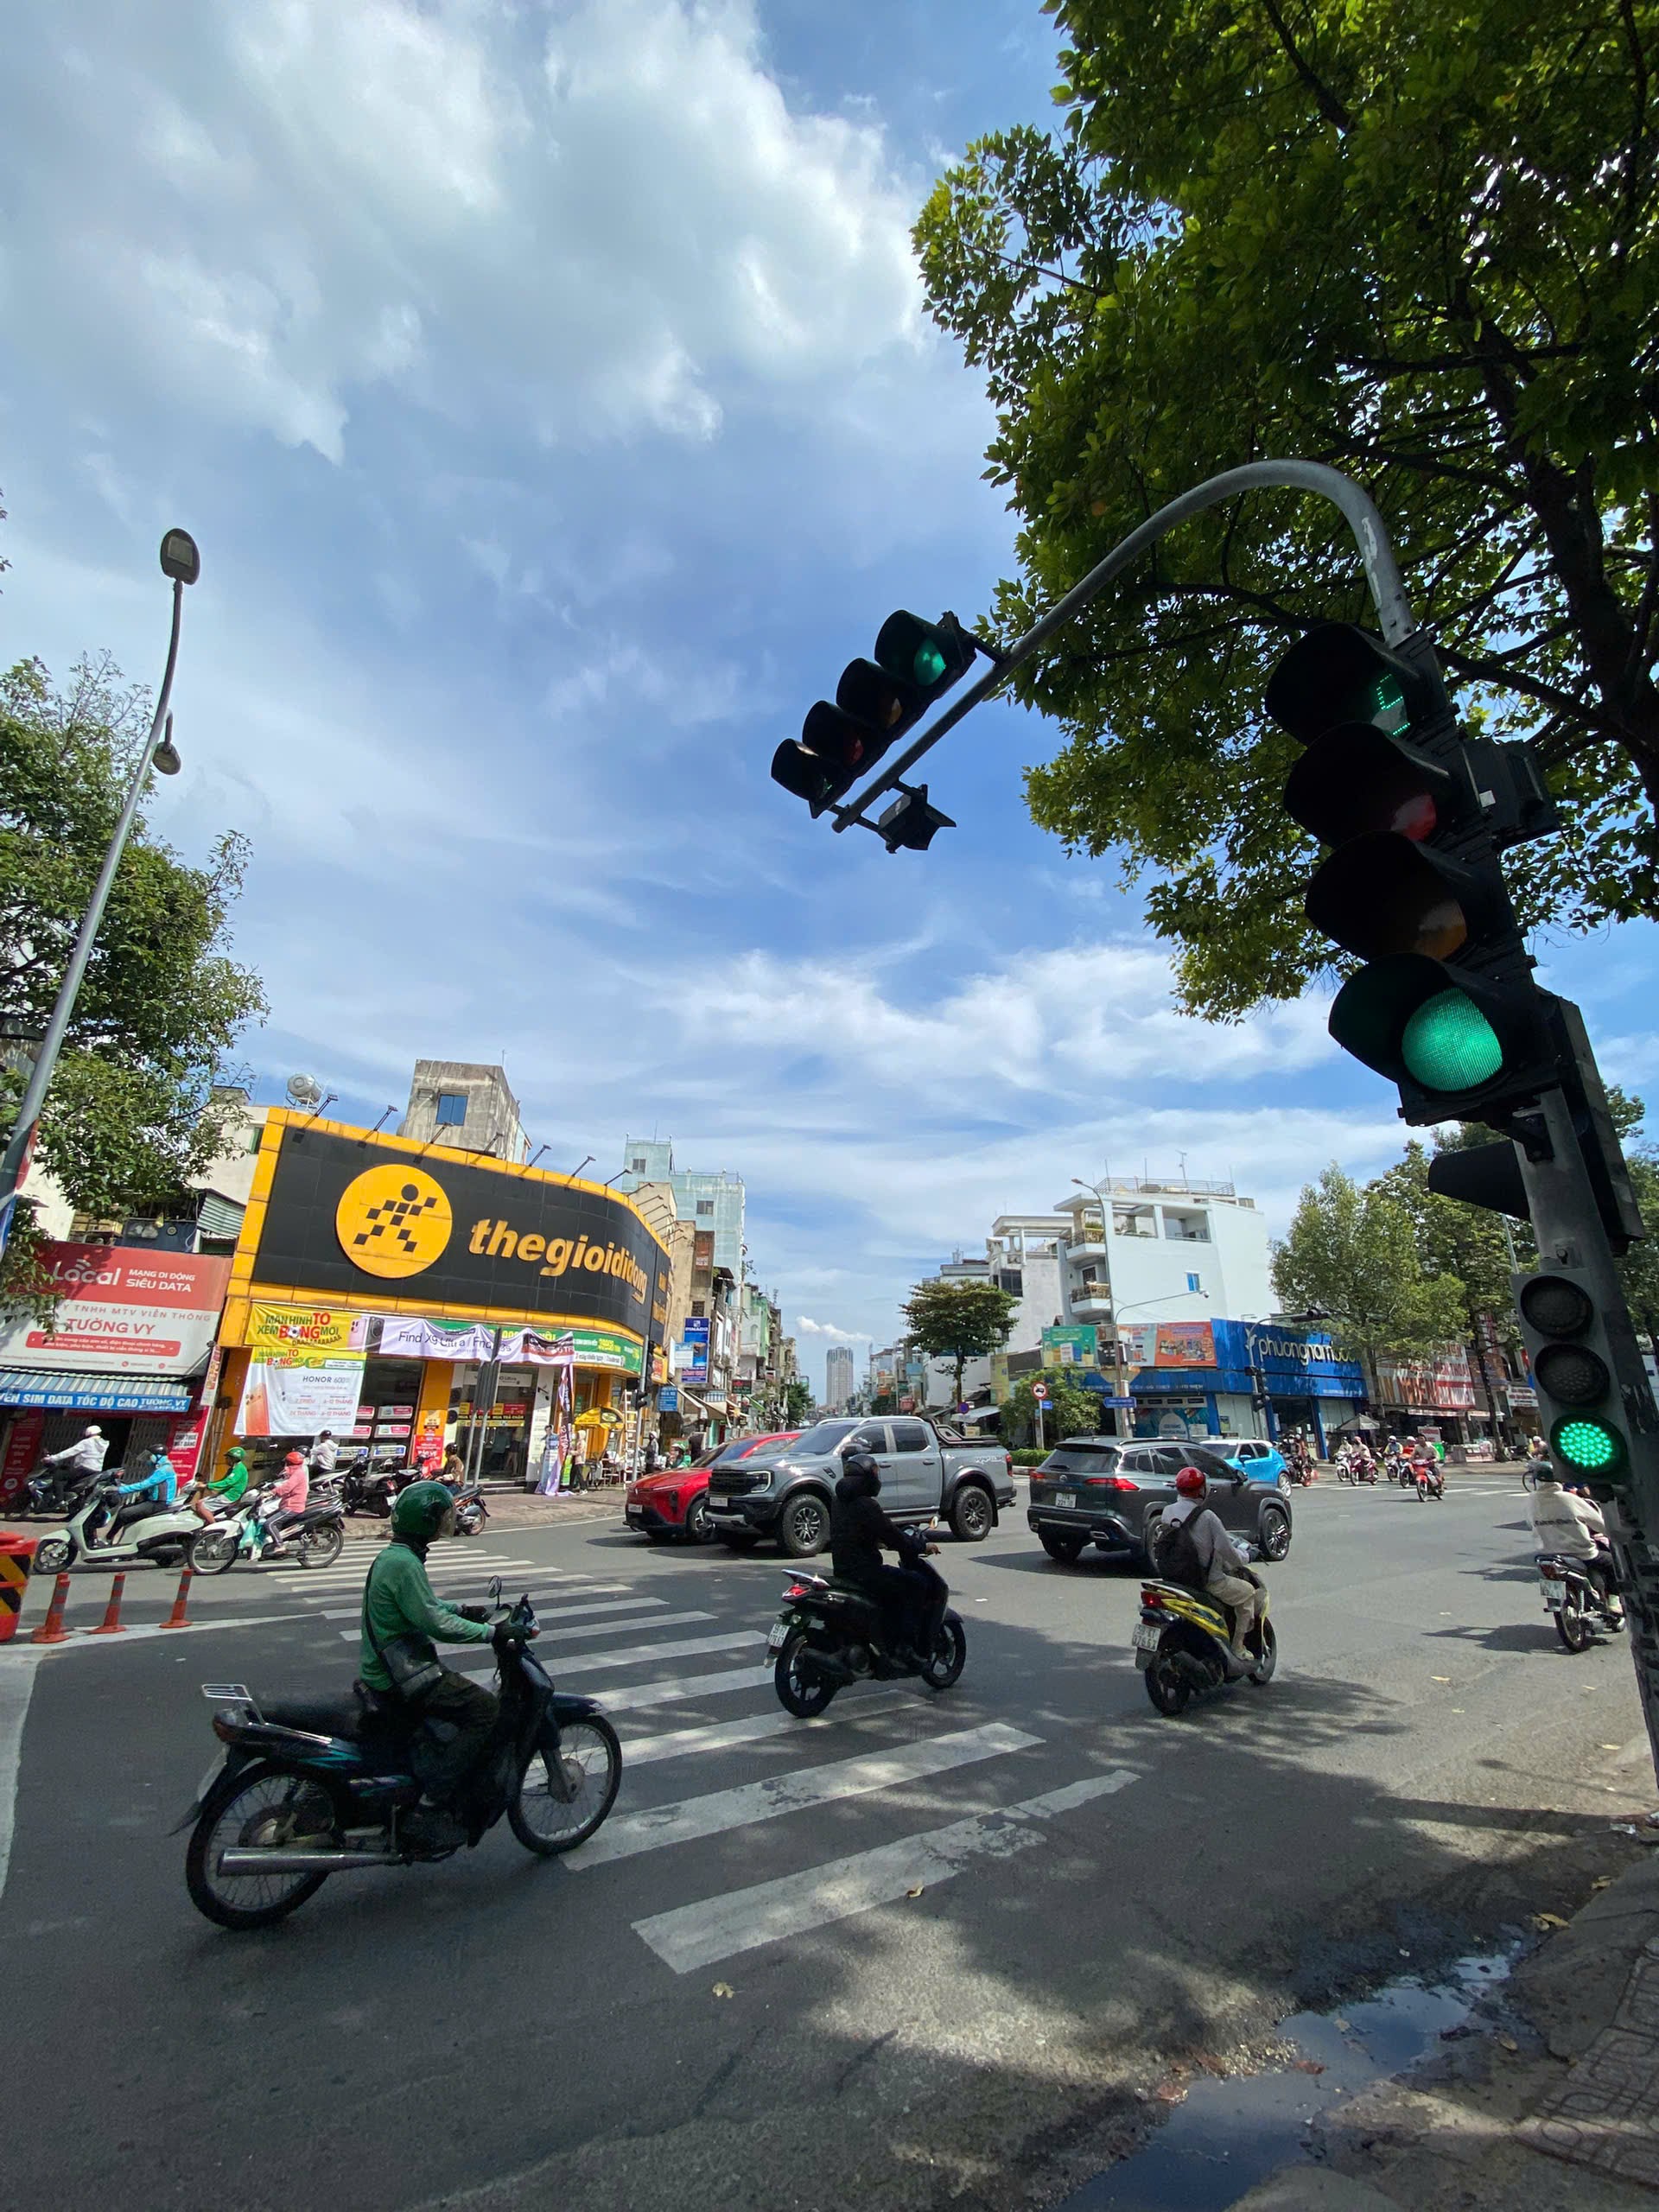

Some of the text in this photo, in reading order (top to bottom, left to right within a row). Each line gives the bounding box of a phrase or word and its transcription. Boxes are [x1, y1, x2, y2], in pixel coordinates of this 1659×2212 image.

[468, 1218, 647, 1305] thegioididong
[52, 1259, 122, 1286] Local
[126, 1279, 192, 1293] SIÊU DATA
[74, 1305, 106, 1314] TNHH
[313, 1313, 331, 1325] TO
[133, 1323, 156, 1335] VY
[398, 1331, 422, 1343] Find
[22, 1394, 45, 1404] SIM
[47, 1395, 73, 1405] DATA
[117, 1398, 138, 1408] CAO
